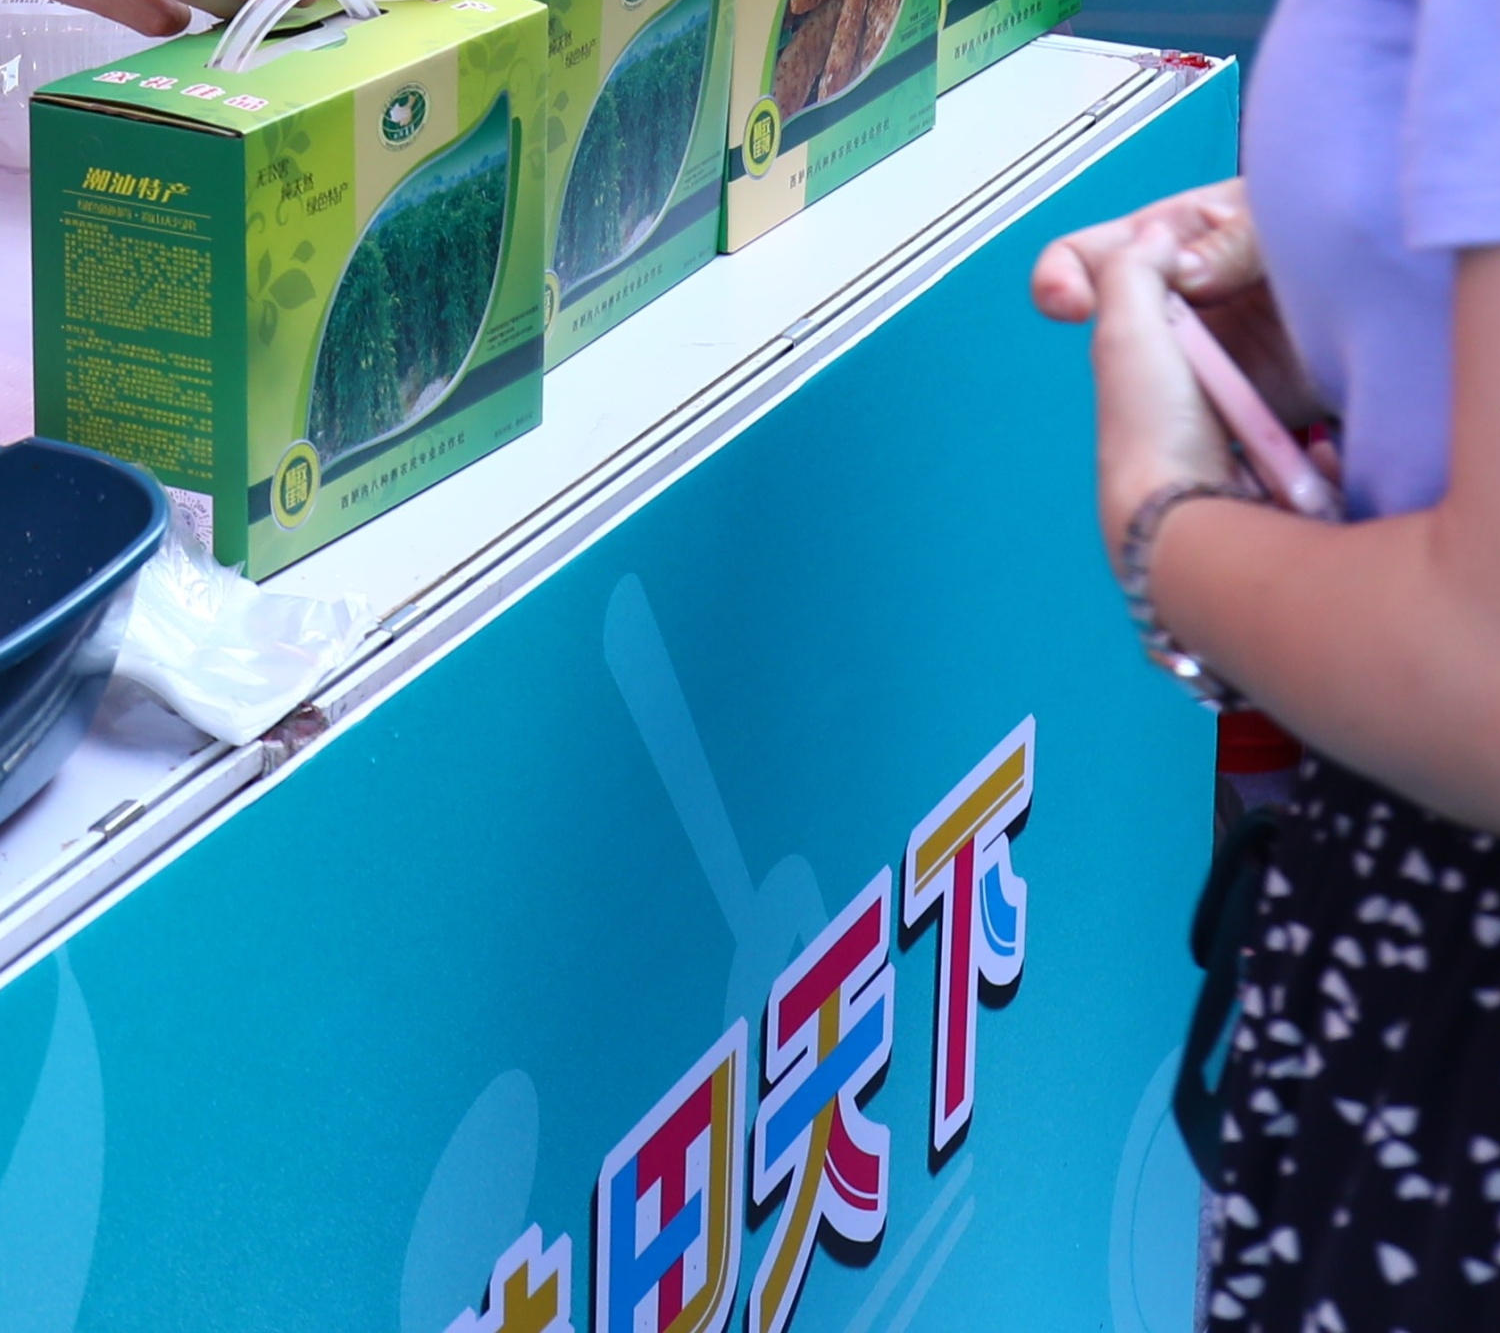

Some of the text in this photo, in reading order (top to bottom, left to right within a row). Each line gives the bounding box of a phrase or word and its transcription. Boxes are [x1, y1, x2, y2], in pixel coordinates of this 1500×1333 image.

[93, 71, 269, 112] 送礼佳品
[82, 167, 192, 204] 潮汕特产
